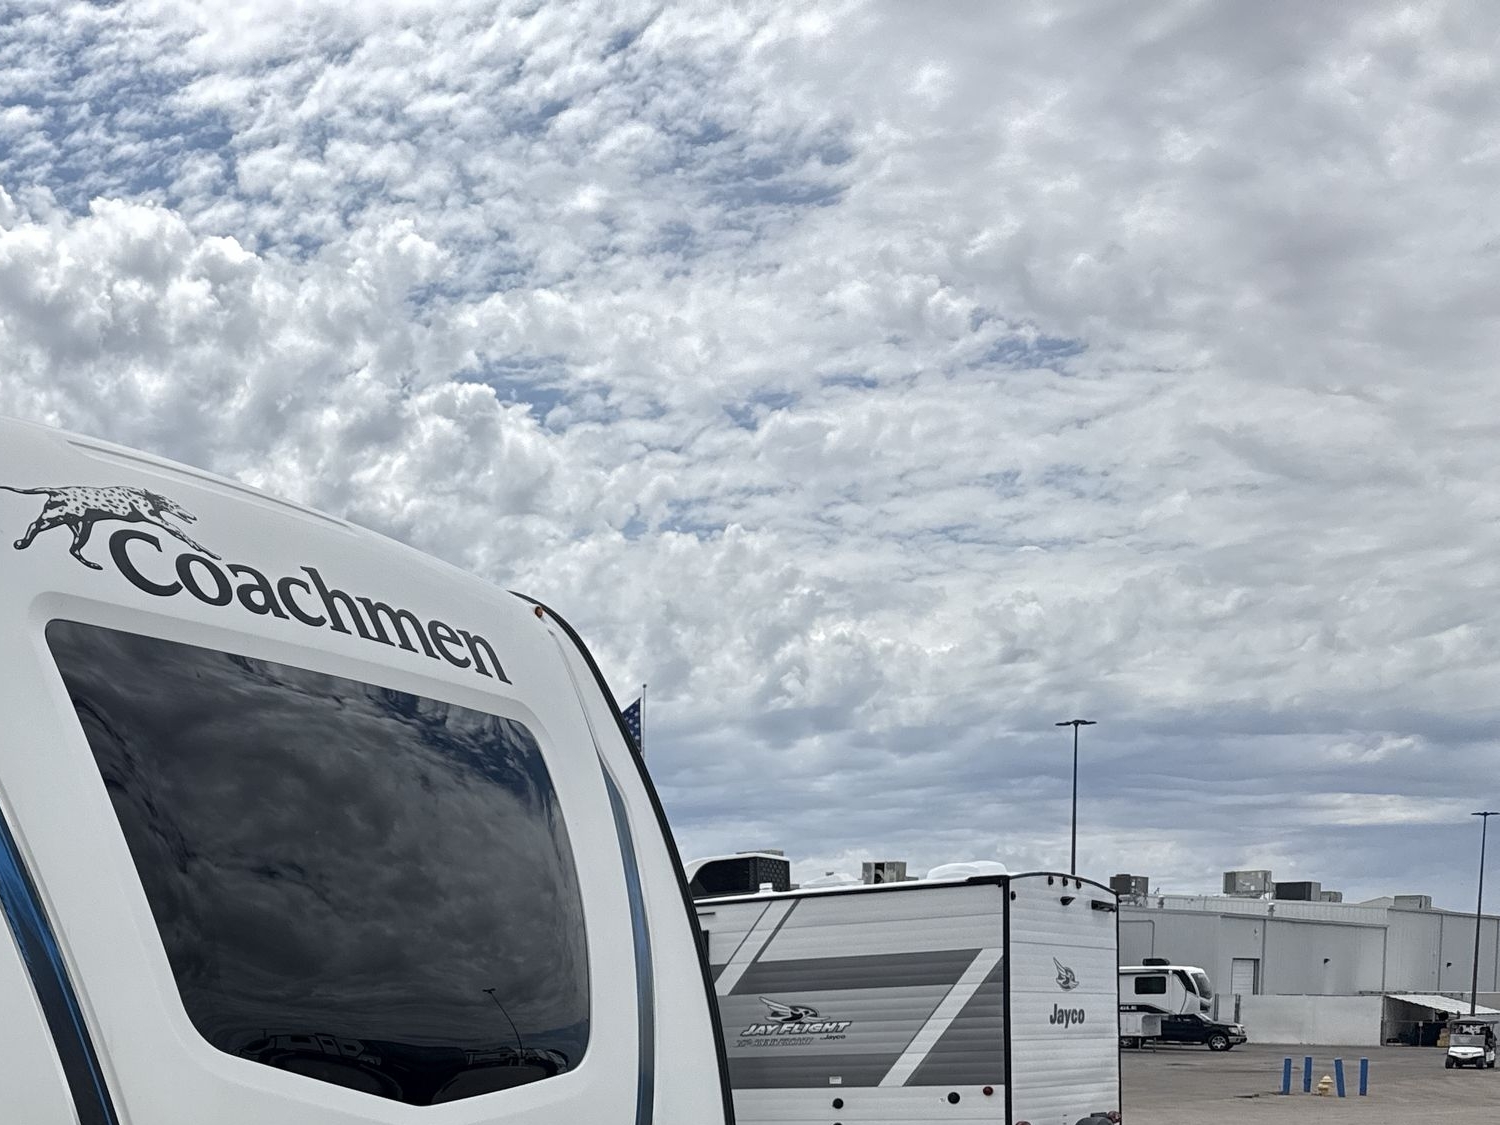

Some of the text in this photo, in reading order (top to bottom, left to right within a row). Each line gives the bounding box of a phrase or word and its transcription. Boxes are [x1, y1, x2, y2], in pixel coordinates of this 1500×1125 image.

[108, 529, 513, 685] Coachmen
[740, 1020, 852, 1037] JAY FLIGHT
[1049, 1003, 1085, 1029] Jayco
